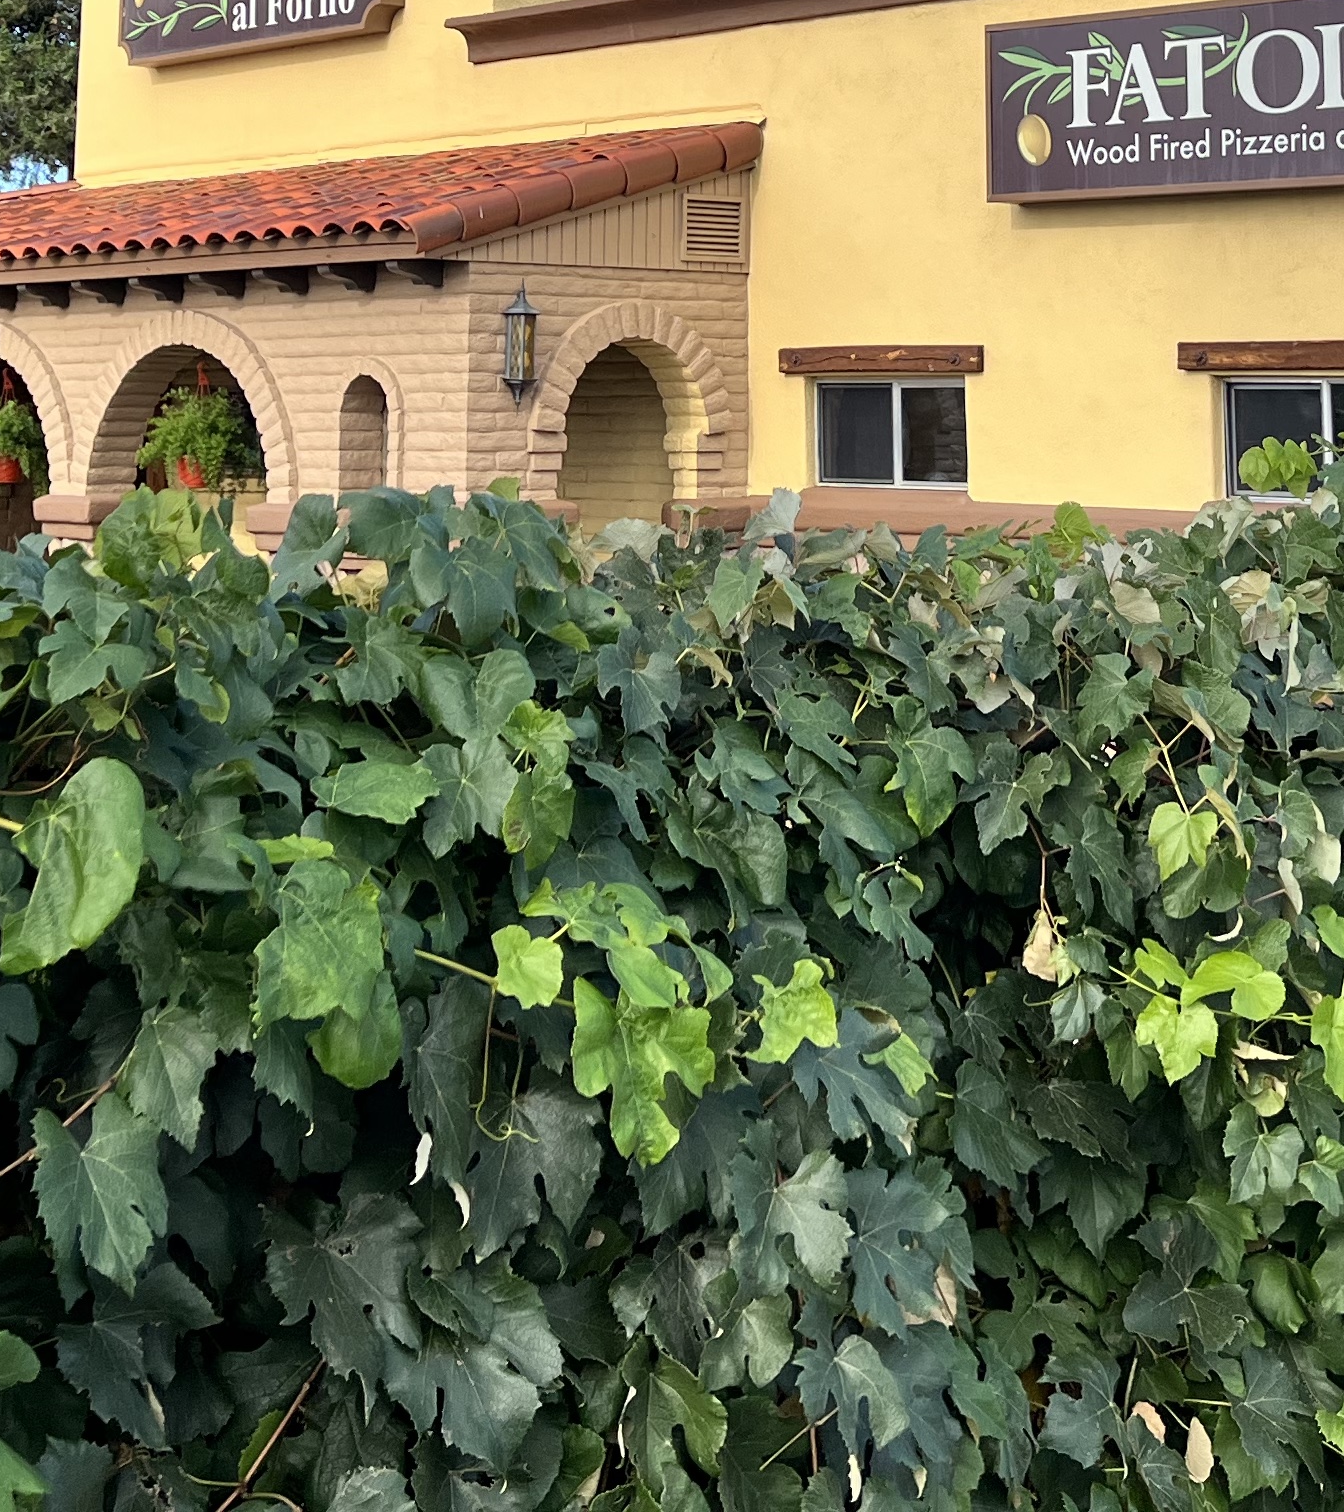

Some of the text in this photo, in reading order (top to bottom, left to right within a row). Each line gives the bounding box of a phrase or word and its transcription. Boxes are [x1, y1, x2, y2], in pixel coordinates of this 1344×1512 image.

[1066, 35, 1228, 129] FAT
[1066, 132, 1140, 167] Wood
[1150, 127, 1211, 162] Fired
[1221, 123, 1325, 157] Pizzeria
